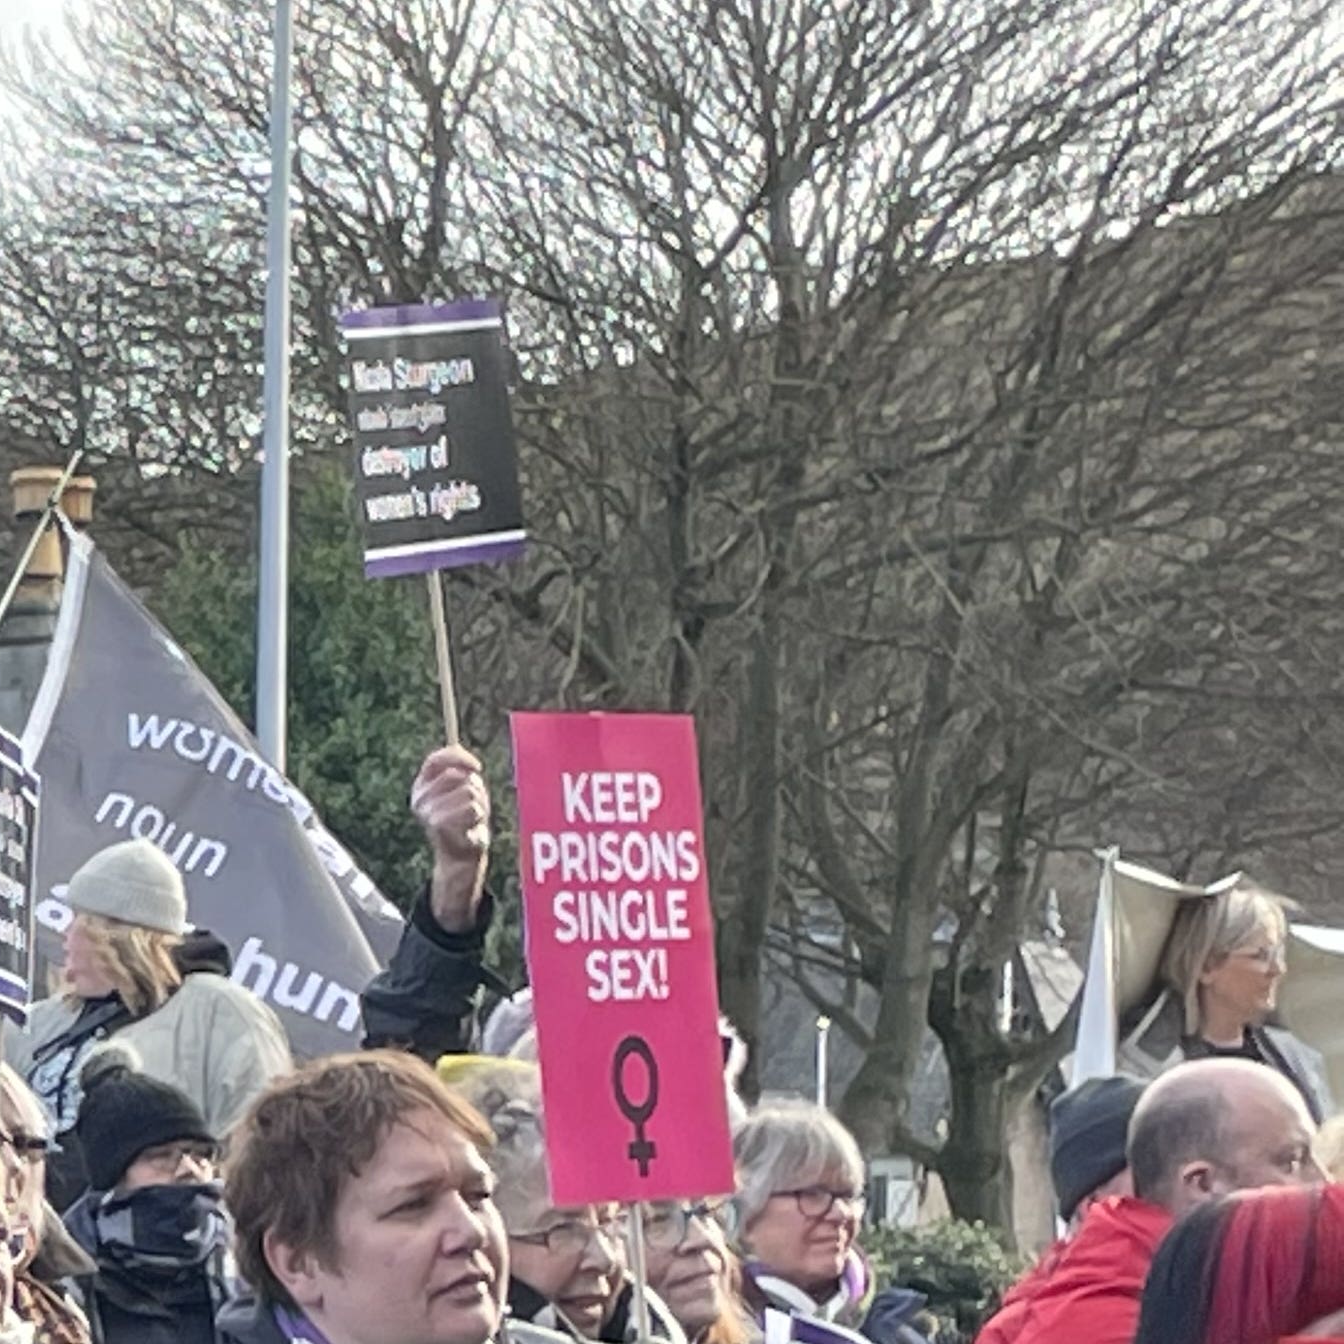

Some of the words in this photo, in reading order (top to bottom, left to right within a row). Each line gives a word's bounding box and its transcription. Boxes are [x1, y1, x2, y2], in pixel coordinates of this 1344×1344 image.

[562, 772, 661, 824] KEEP
[94, 792, 229, 878] noun
[531, 831, 700, 884] PRISONS
[553, 889, 691, 943] SINGLE
[586, 948, 669, 1001] SEX!
